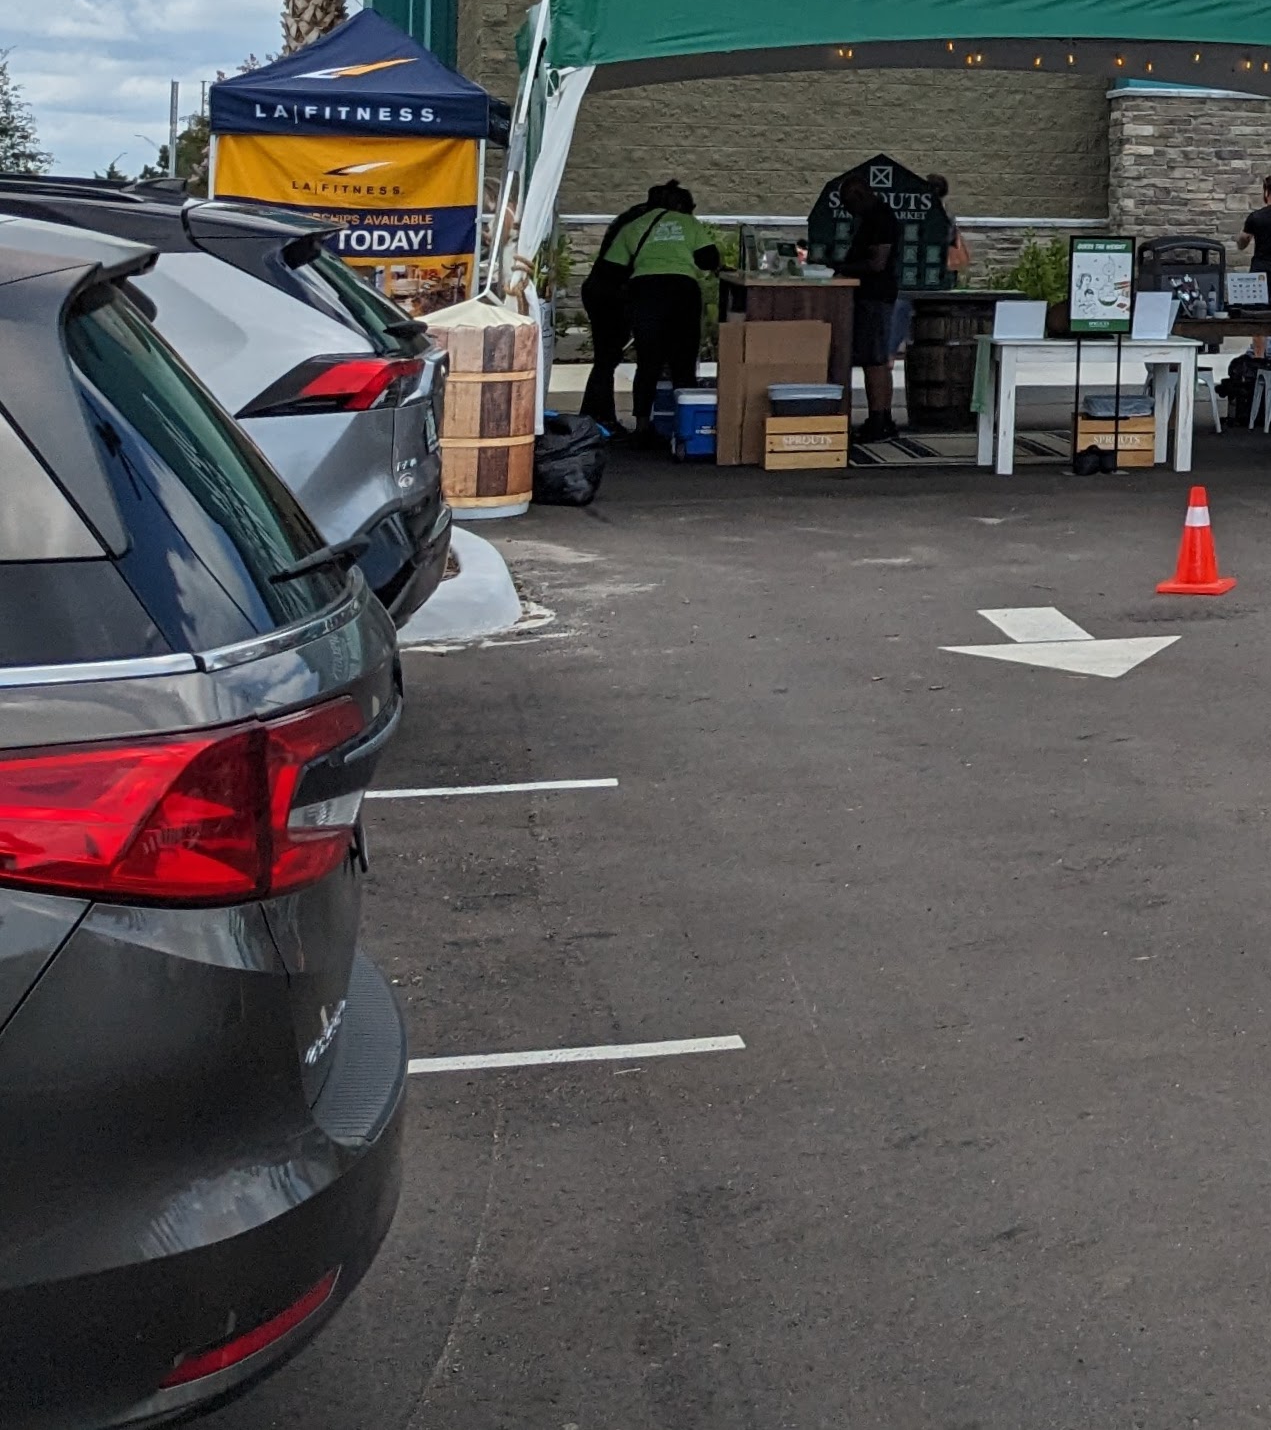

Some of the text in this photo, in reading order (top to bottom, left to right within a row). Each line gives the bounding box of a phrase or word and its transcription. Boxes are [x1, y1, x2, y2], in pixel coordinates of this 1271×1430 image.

[364, 214, 434, 225] AVAILABLE
[338, 230, 434, 251] TODAY!
[782, 434, 832, 446] SPROUTS
[1093, 434, 1141, 445] SPRUTS
